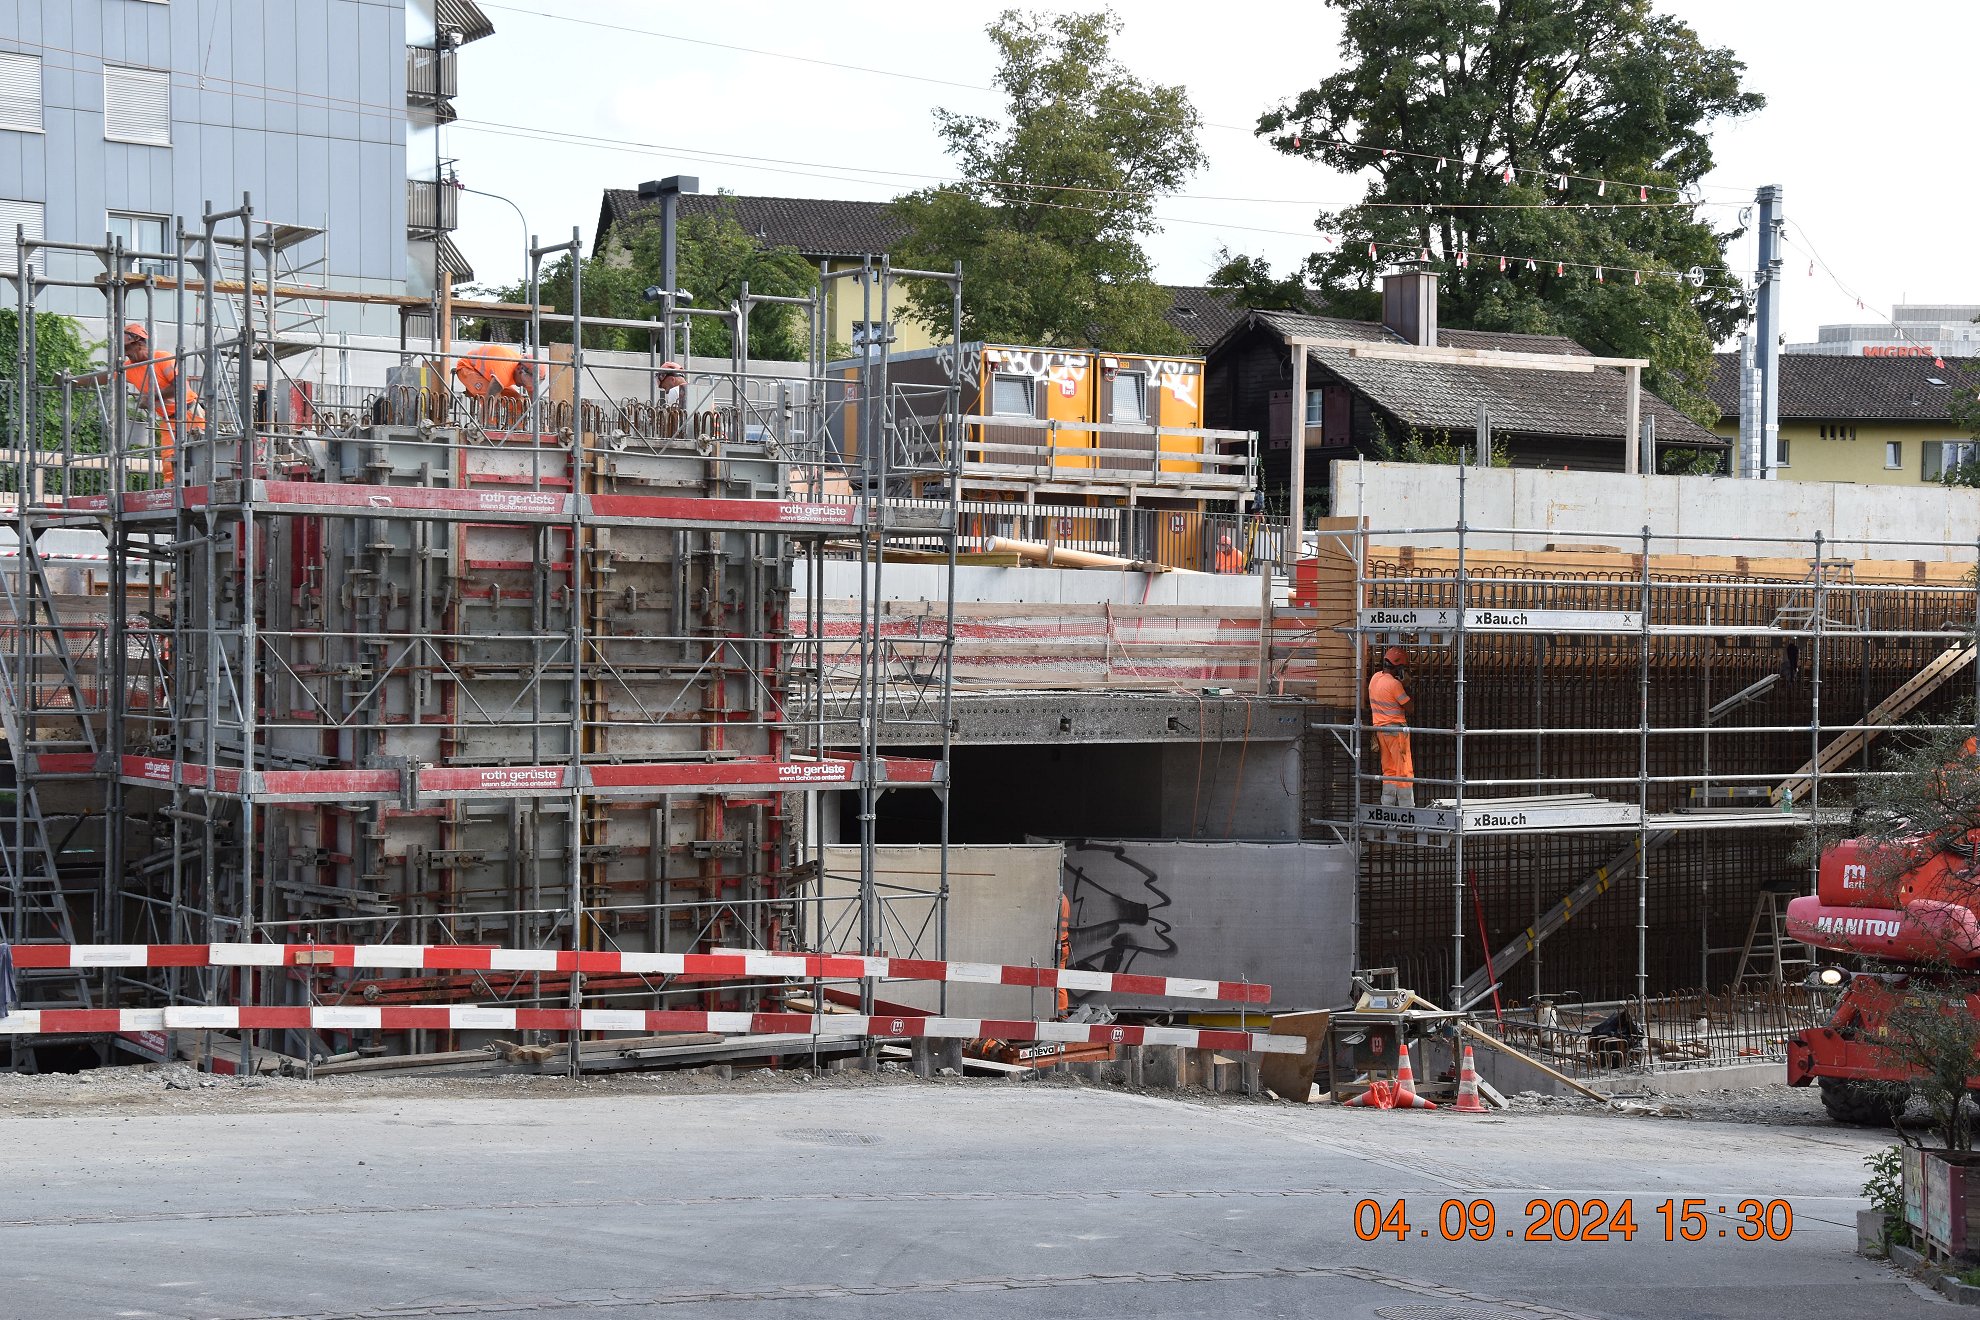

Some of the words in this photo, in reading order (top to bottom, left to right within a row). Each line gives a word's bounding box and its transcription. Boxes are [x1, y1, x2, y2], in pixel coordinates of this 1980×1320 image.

[1863, 346, 1933, 357] MIGROS
[480, 493, 506, 502] roth
[508, 494, 555, 505] gerüste
[780, 505, 802, 514] roth
[805, 506, 846, 517] gerüste
[1370, 611, 1417, 624] xBau.ch
[1475, 612, 1528, 625] xBau.ch
[481, 770, 507, 780] roth
[509, 769, 557, 782] gerüste
[778, 764, 801, 775] roth
[804, 764, 846, 776] gerüste
[1368, 808, 1415, 824] xBau.ch
[1473, 813, 1526, 827] xBau.ch
[1818, 917, 1900, 938] MANITOU
[1028, 1046, 1054, 1057] meva
